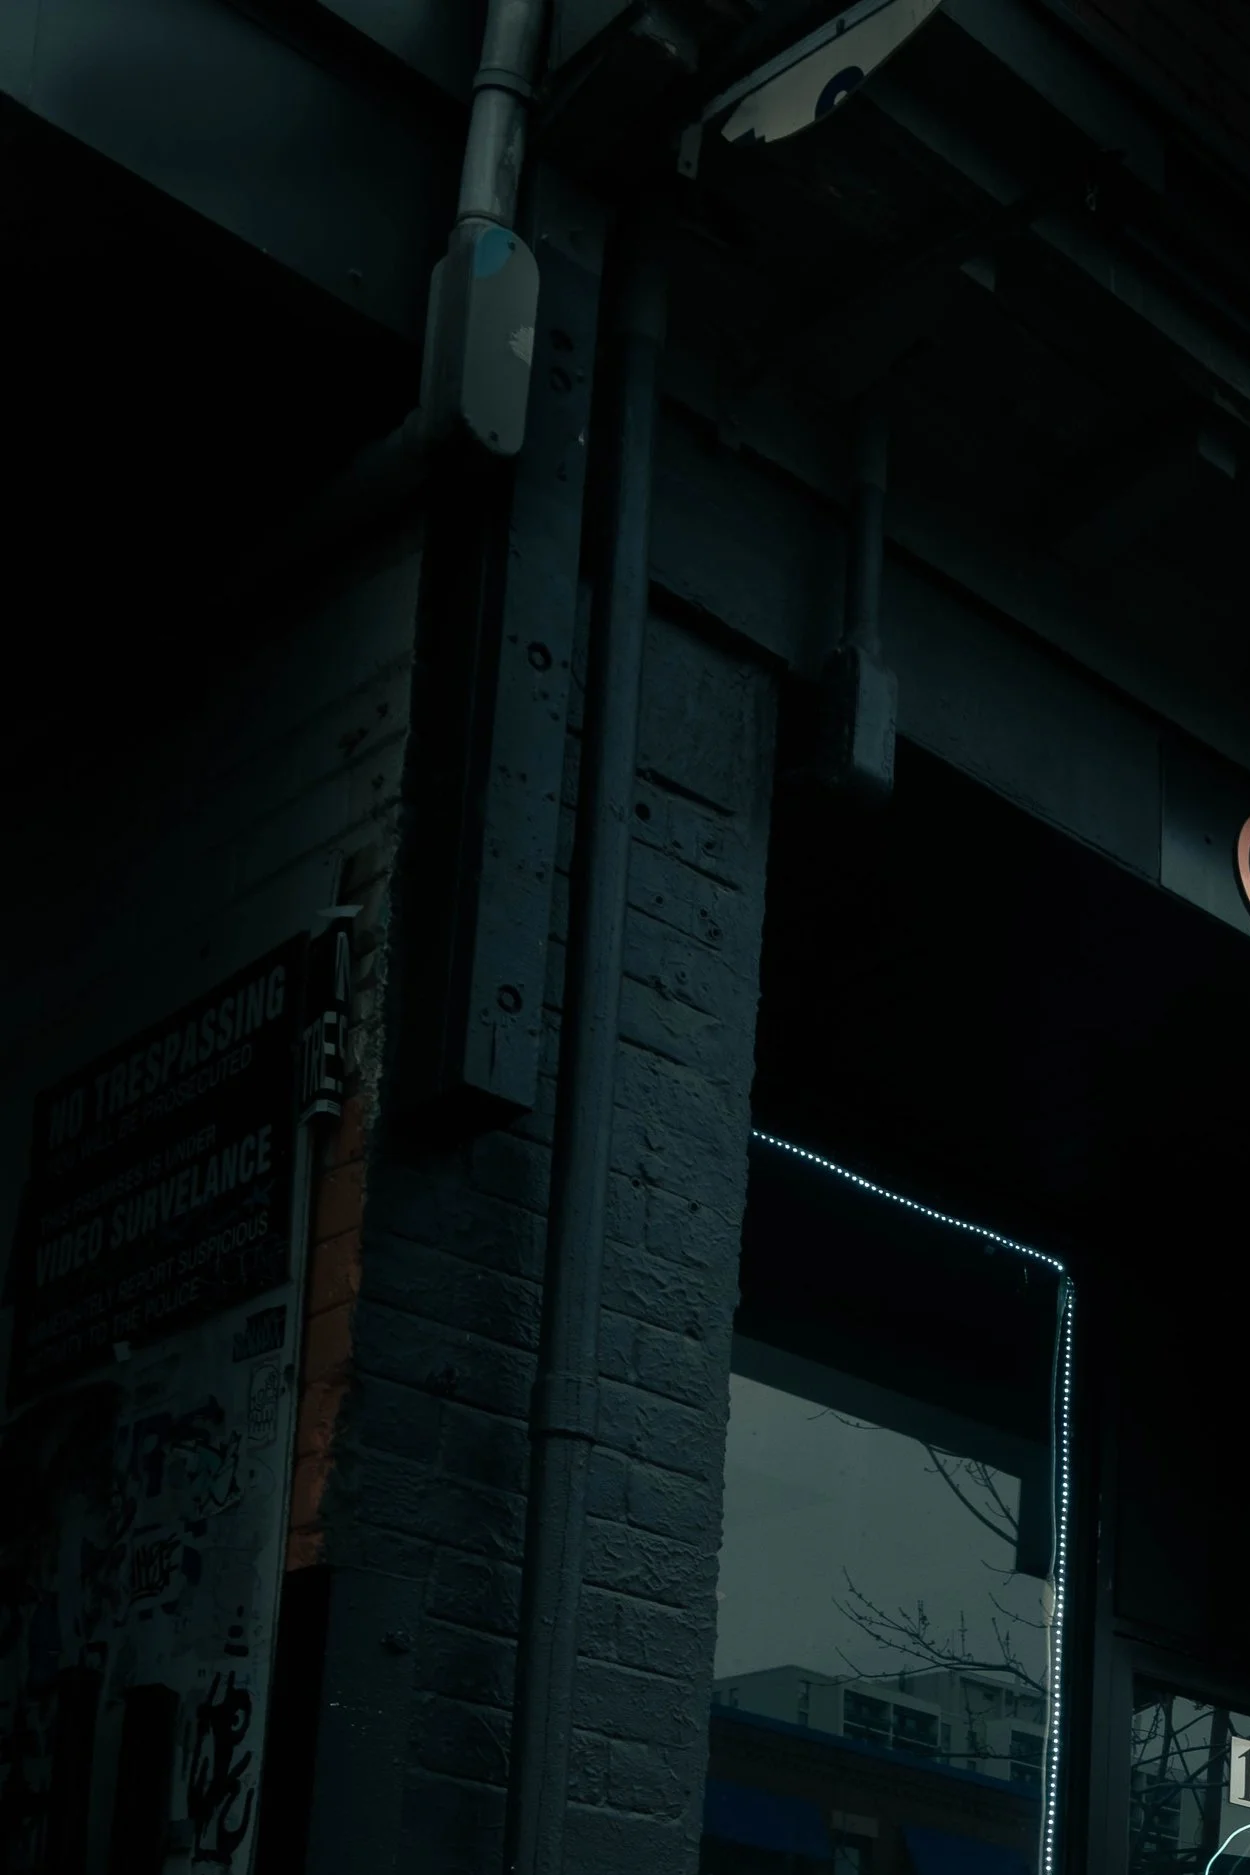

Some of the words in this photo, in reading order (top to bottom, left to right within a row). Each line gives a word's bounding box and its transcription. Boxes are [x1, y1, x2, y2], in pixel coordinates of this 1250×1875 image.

[48, 1087, 86, 1152] NO
[94, 963, 288, 1122] TRESPASSING
[141, 1041, 254, 1130] PROSECUTED
[164, 1122, 216, 1170] UNDER
[36, 1215, 104, 1289] VIDEO
[109, 1122, 274, 1252] SURVELANCE
[177, 1208, 269, 1278] SUSPICIOUS
[112, 1304, 142, 1340] THE
[143, 1275, 201, 1331] POLICE
